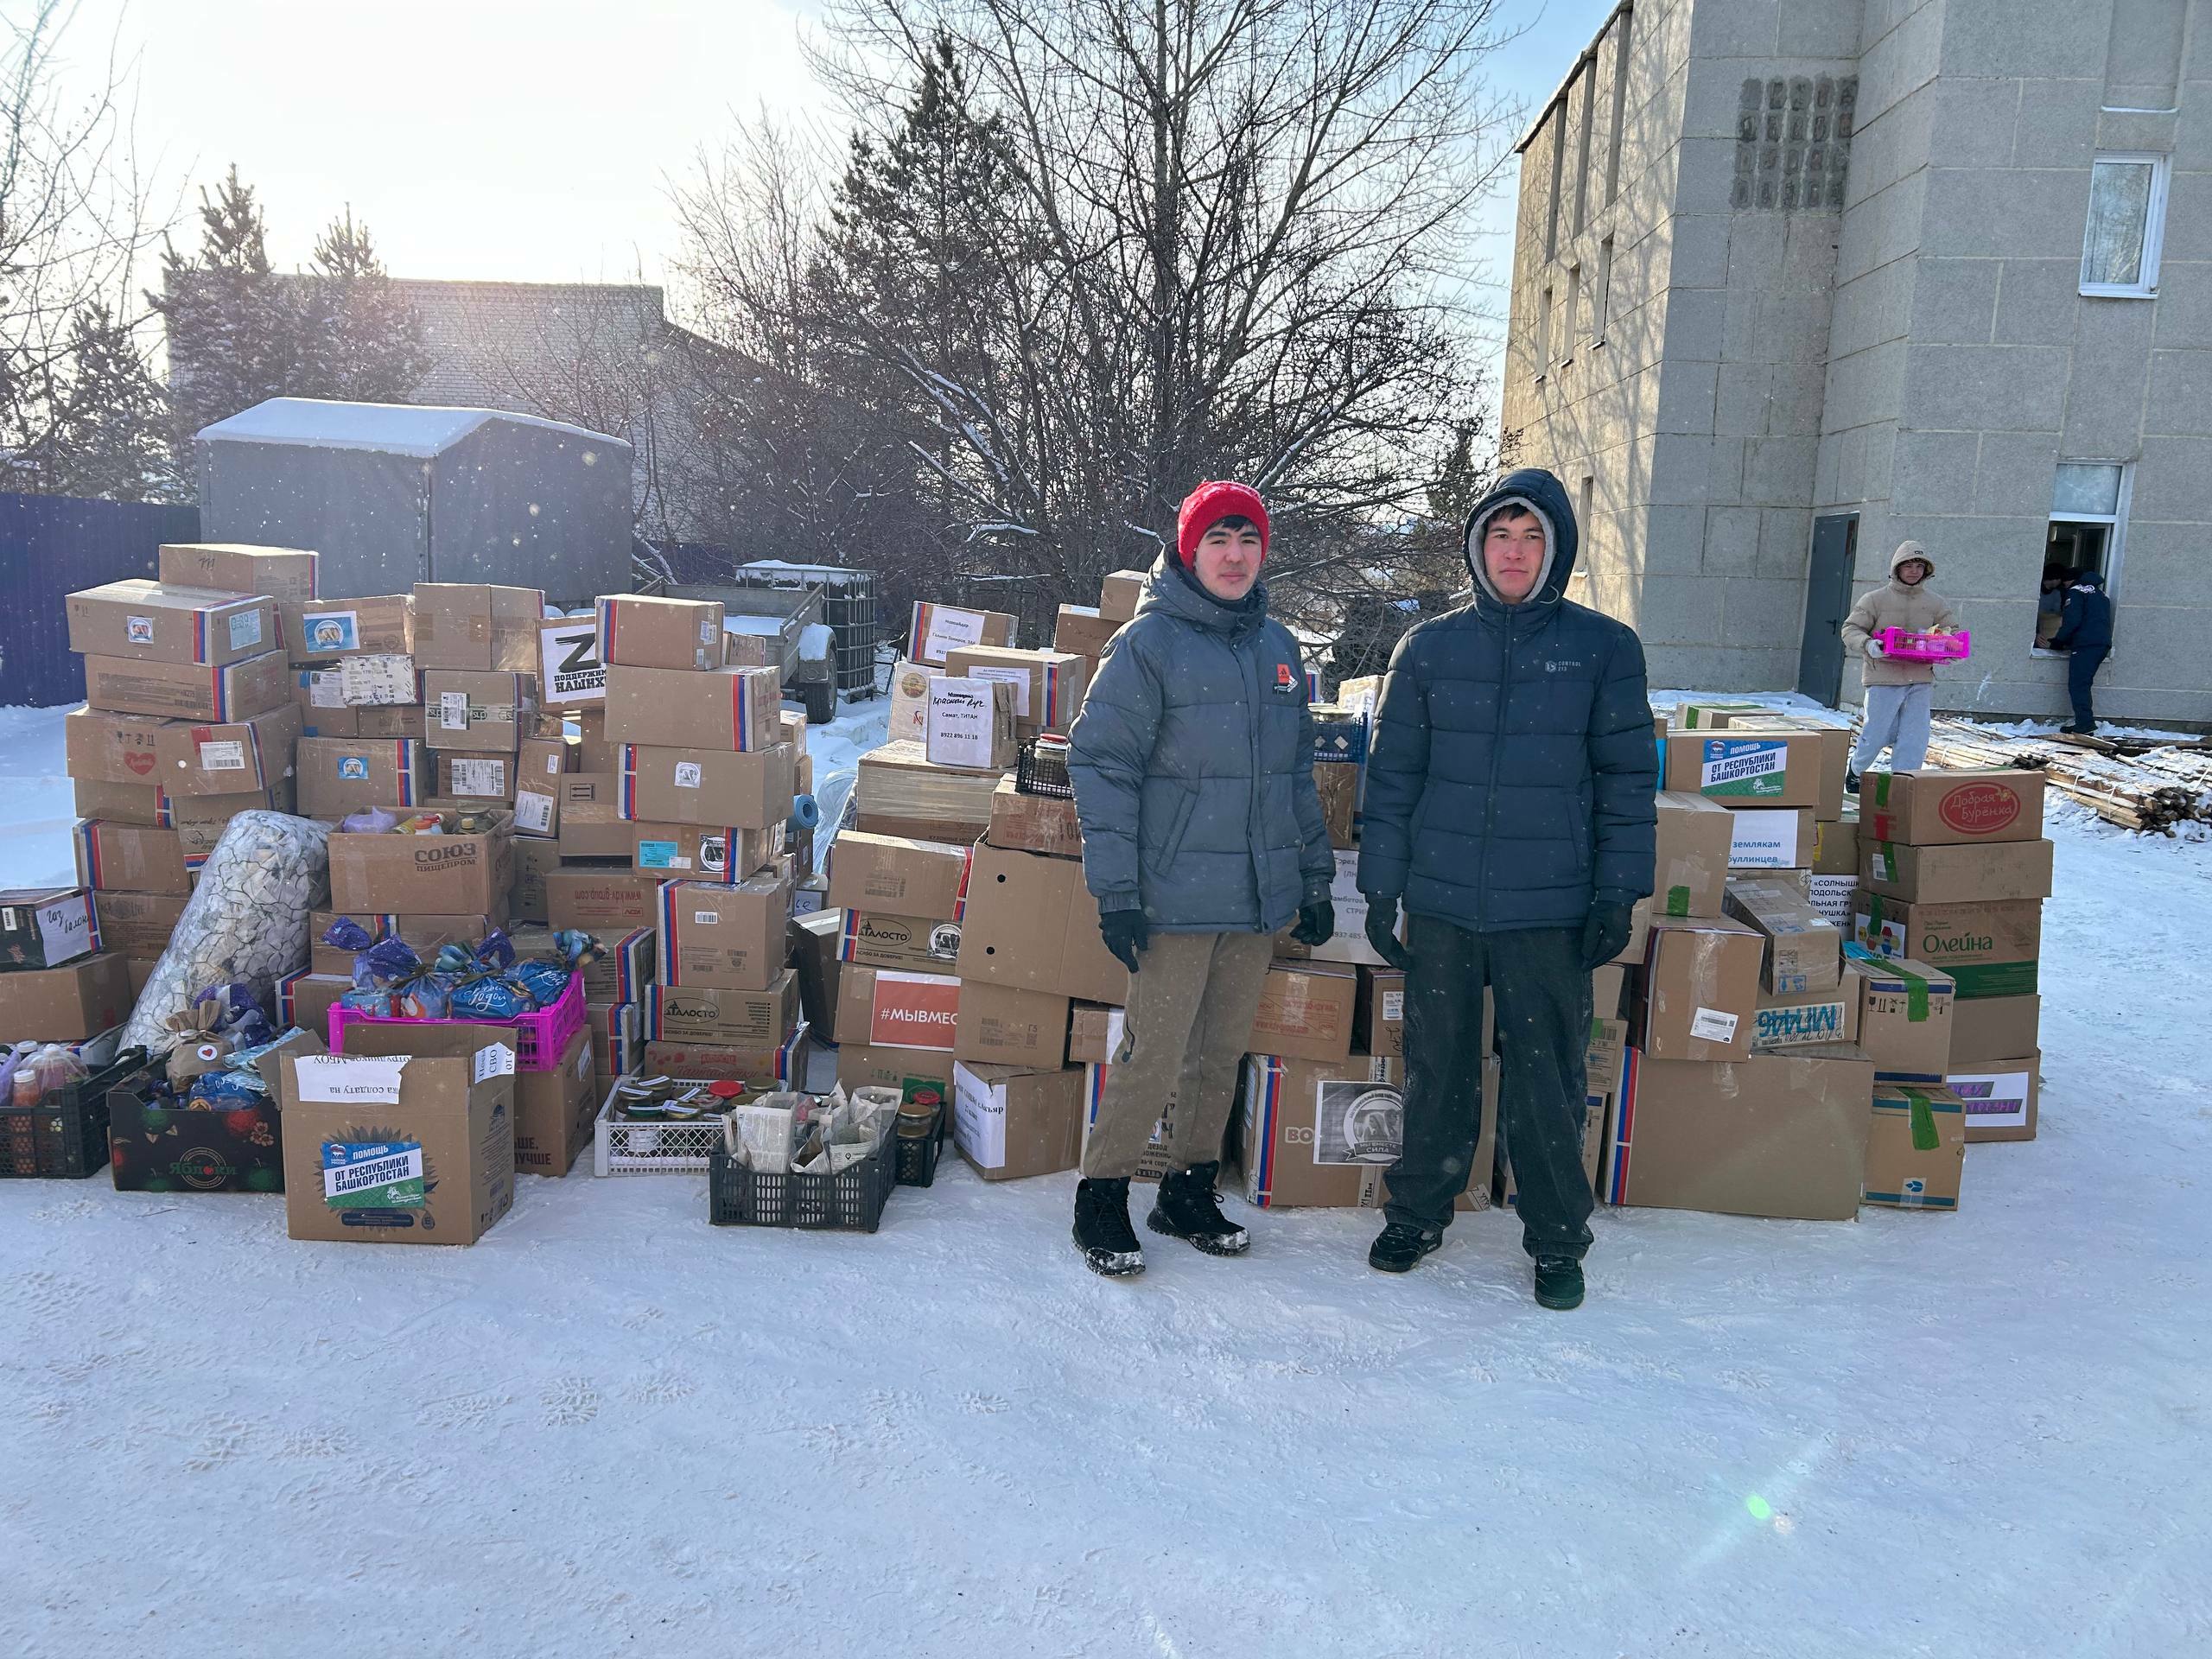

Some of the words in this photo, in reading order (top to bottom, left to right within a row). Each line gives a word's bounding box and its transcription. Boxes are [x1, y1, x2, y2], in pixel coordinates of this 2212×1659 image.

[555, 632, 601, 673] Z
[1730, 742, 1761, 754] ПОМОЩЬ
[1711, 761, 1776, 782] БАШКОРТОСТАН
[1712, 763, 1721, 773] ОТ
[1725, 752, 1777, 771] РЕСПУБЛИКИ
[1950, 791, 1995, 810] Добрая
[415, 842, 477, 862] СОЮЗ
[416, 859, 476, 873] ПИЩЕПРОМ
[1923, 931, 1993, 953] Олейна
[880, 1007, 958, 1026] #МЫВМЕС
[489, 1049, 498, 1073] СВО
[329, 1085, 340, 1094] на
[343, 1084, 385, 1095] солдату
[353, 1145, 389, 1160] ПОМОЩЬ
[514, 1137, 539, 1150] ШЕ.
[334, 1170, 346, 1182] ОТ
[348, 1155, 409, 1178] РЕСПУБЛИКИ
[335, 1166, 410, 1192] БАШКОРТОСТАН
